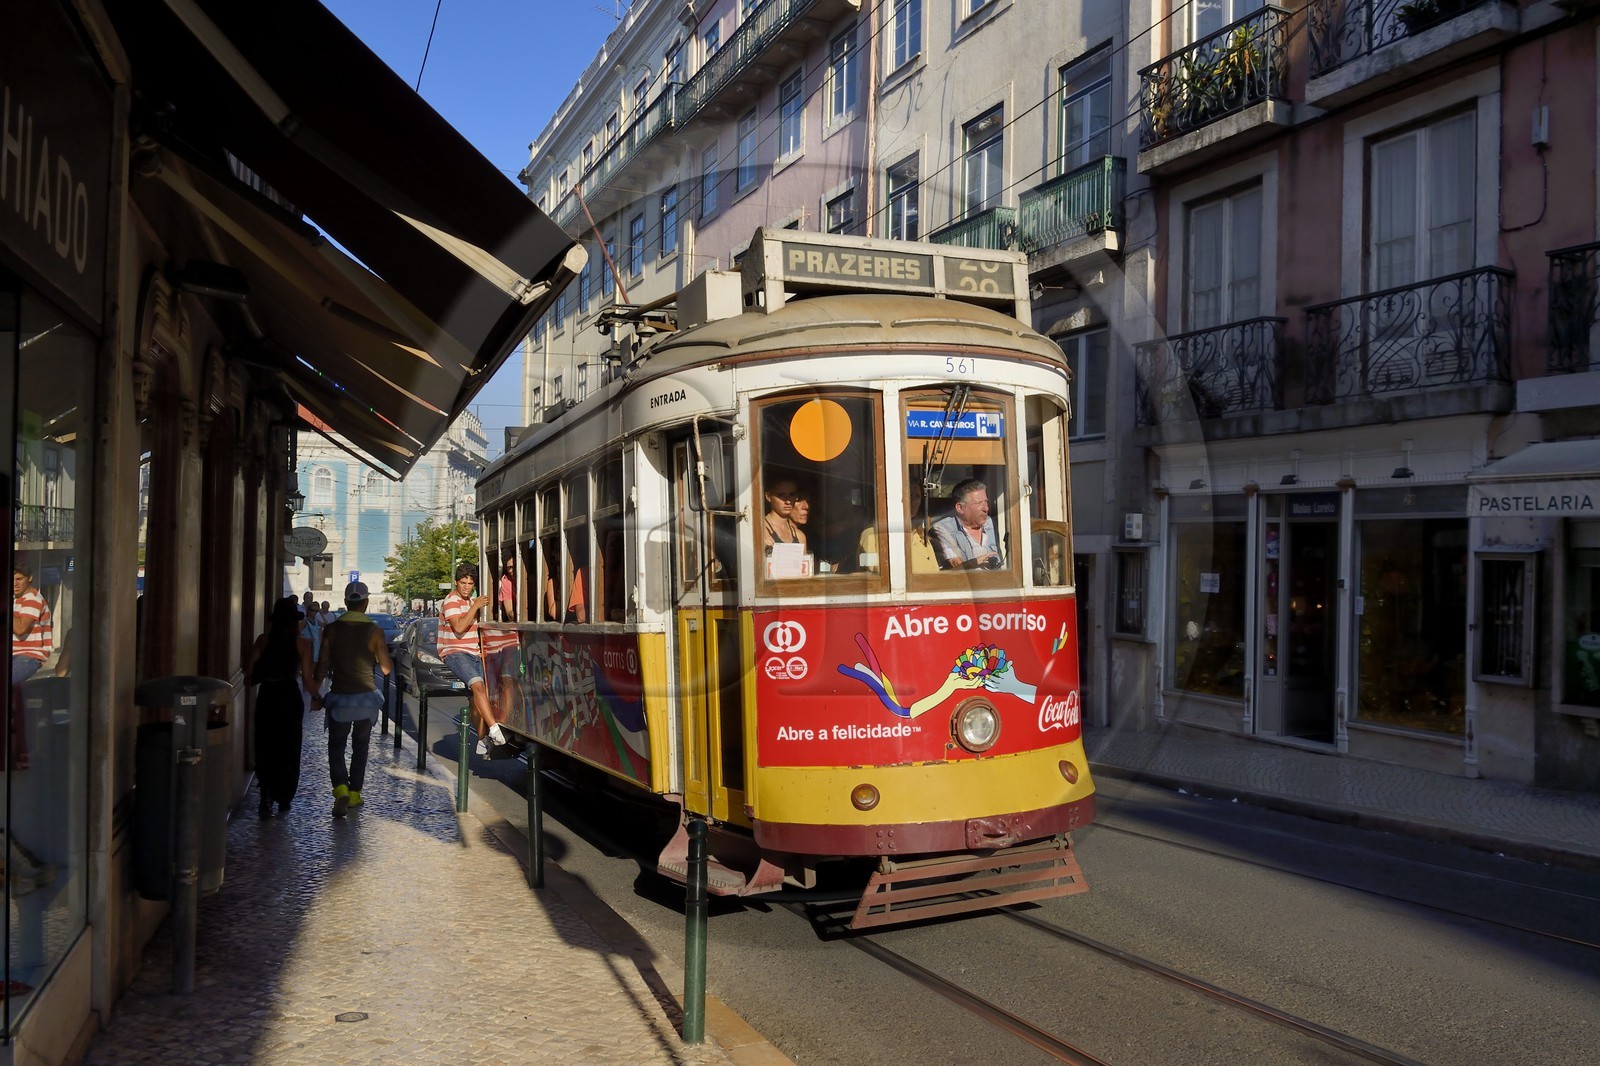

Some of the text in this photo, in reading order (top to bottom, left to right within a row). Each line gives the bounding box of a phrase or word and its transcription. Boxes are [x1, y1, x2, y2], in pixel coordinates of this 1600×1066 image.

[1, 86, 89, 274] HIADO
[788, 249, 921, 281] PRAZERES
[946, 357, 976, 375] 561
[650, 388, 687, 409] ENTRADA
[908, 420, 920, 428] VIA
[920, 420, 928, 428] R.
[1313, 502, 1335, 513] Loreto
[1479, 495, 1594, 512] PASTELARIA
[351, 574, 358, 582] P
[884, 608, 1046, 641] Abre o sorriso
[603, 645, 625, 670] carris
[1038, 690, 1079, 733] Coca-Col
[776, 725, 815, 741] Abre
[818, 729, 828, 740] a
